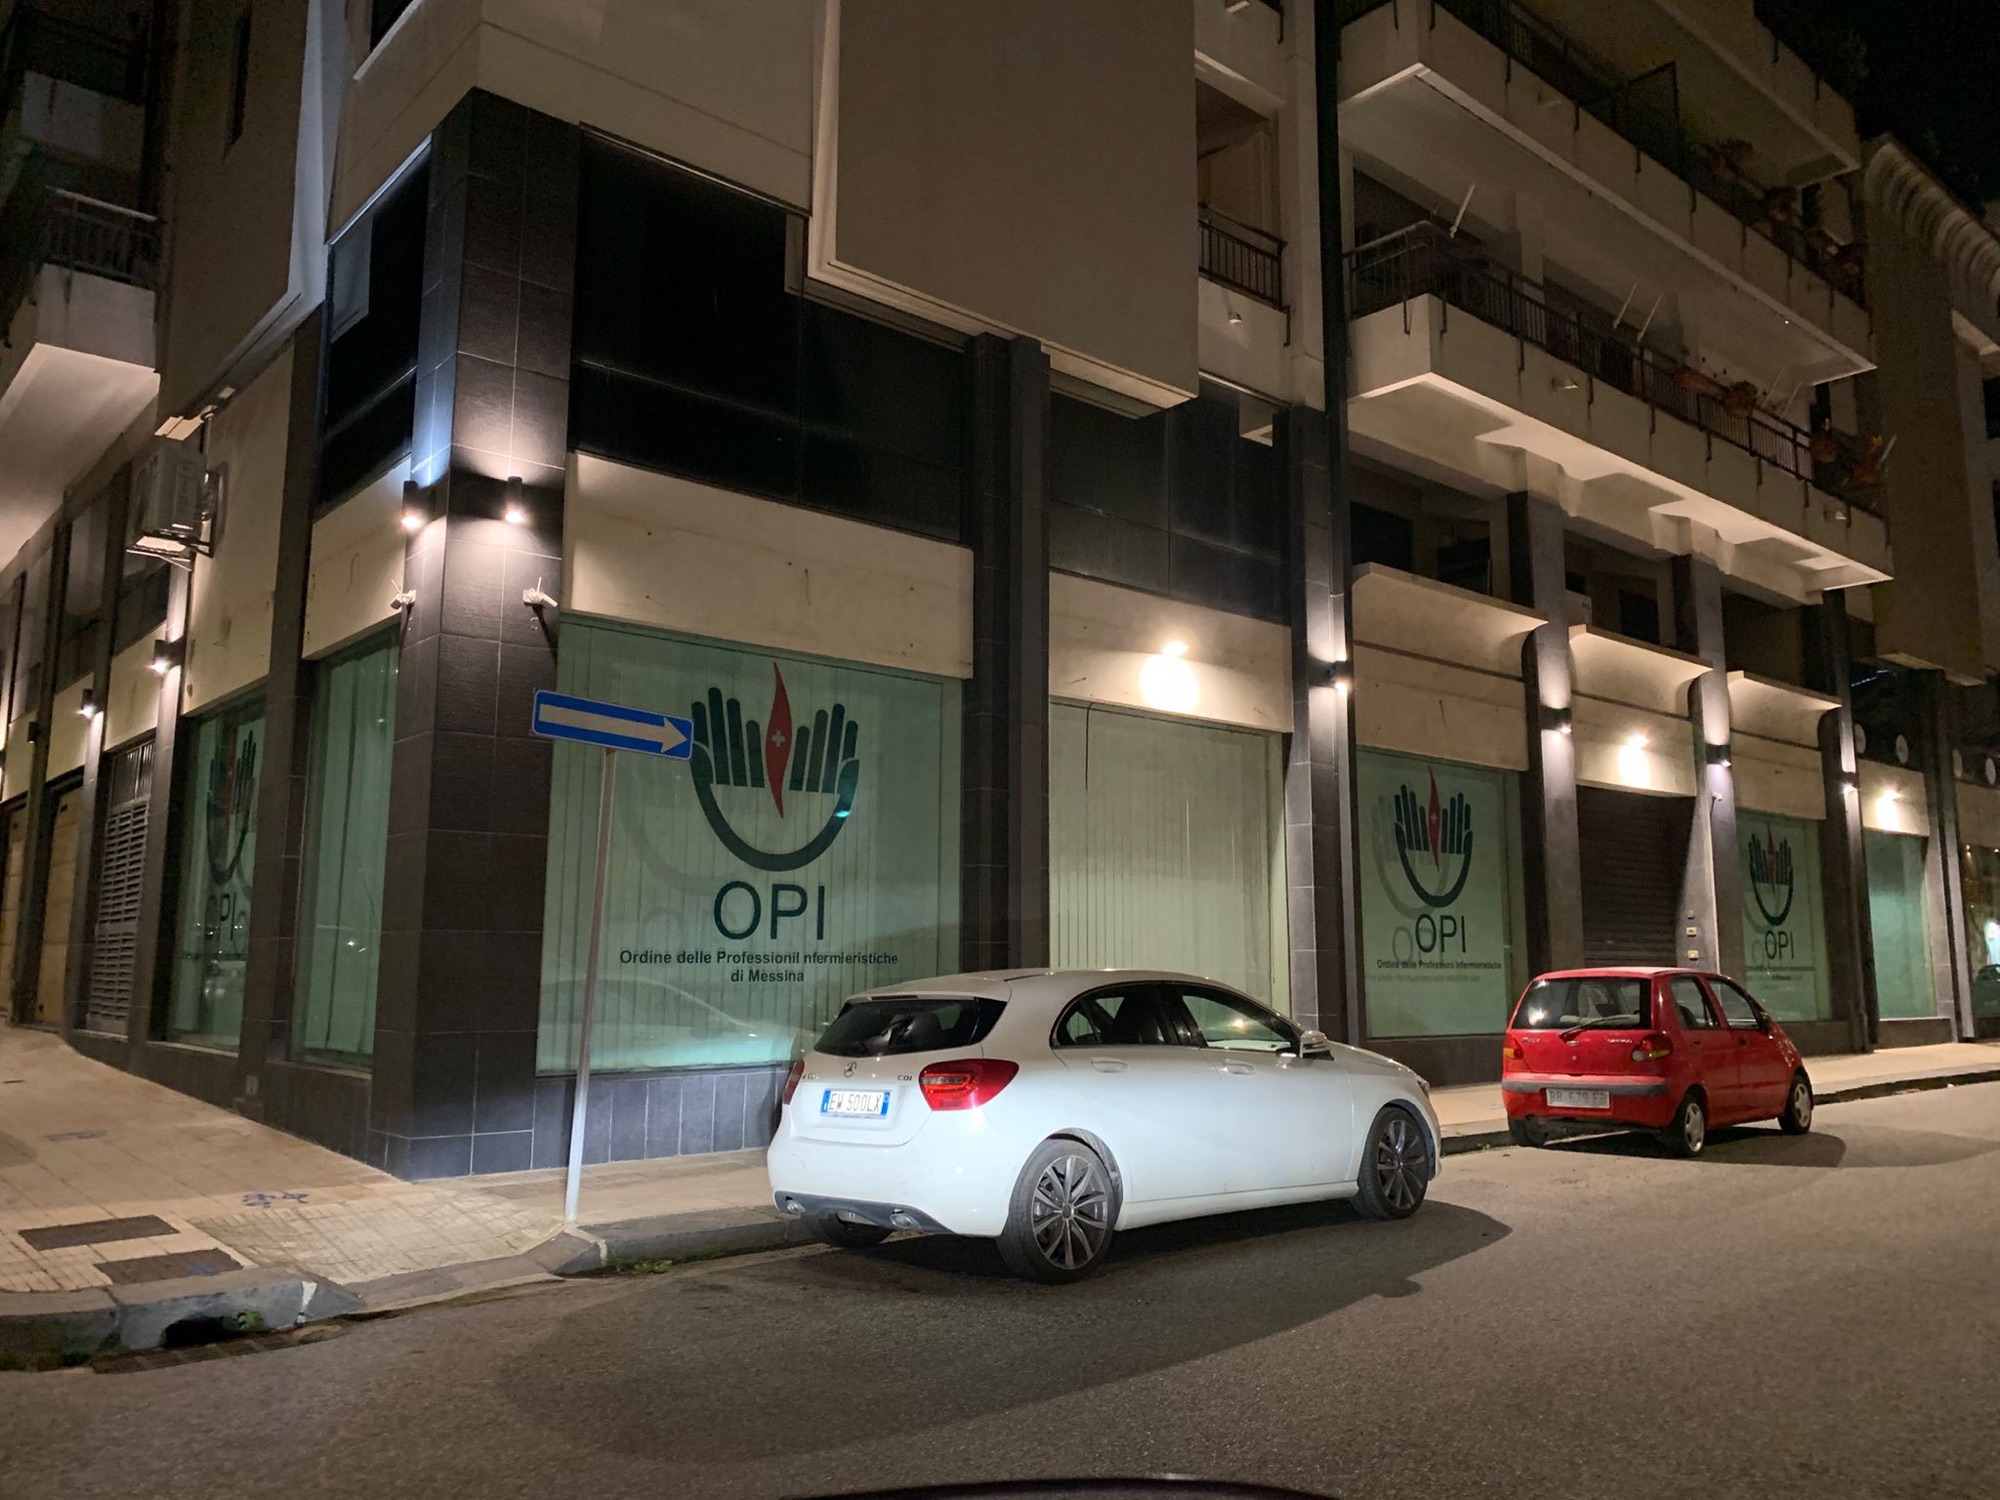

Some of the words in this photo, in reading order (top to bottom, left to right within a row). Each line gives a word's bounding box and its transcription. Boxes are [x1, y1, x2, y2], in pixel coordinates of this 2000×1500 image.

[714, 880, 825, 941] OPI
[1415, 913, 1466, 953] OPI
[1765, 930, 1794, 959] OPI
[620, 950, 672, 964] Ordine
[676, 951, 712, 964] delle
[730, 969, 744, 982] di
[748, 969, 804, 982] Messina
